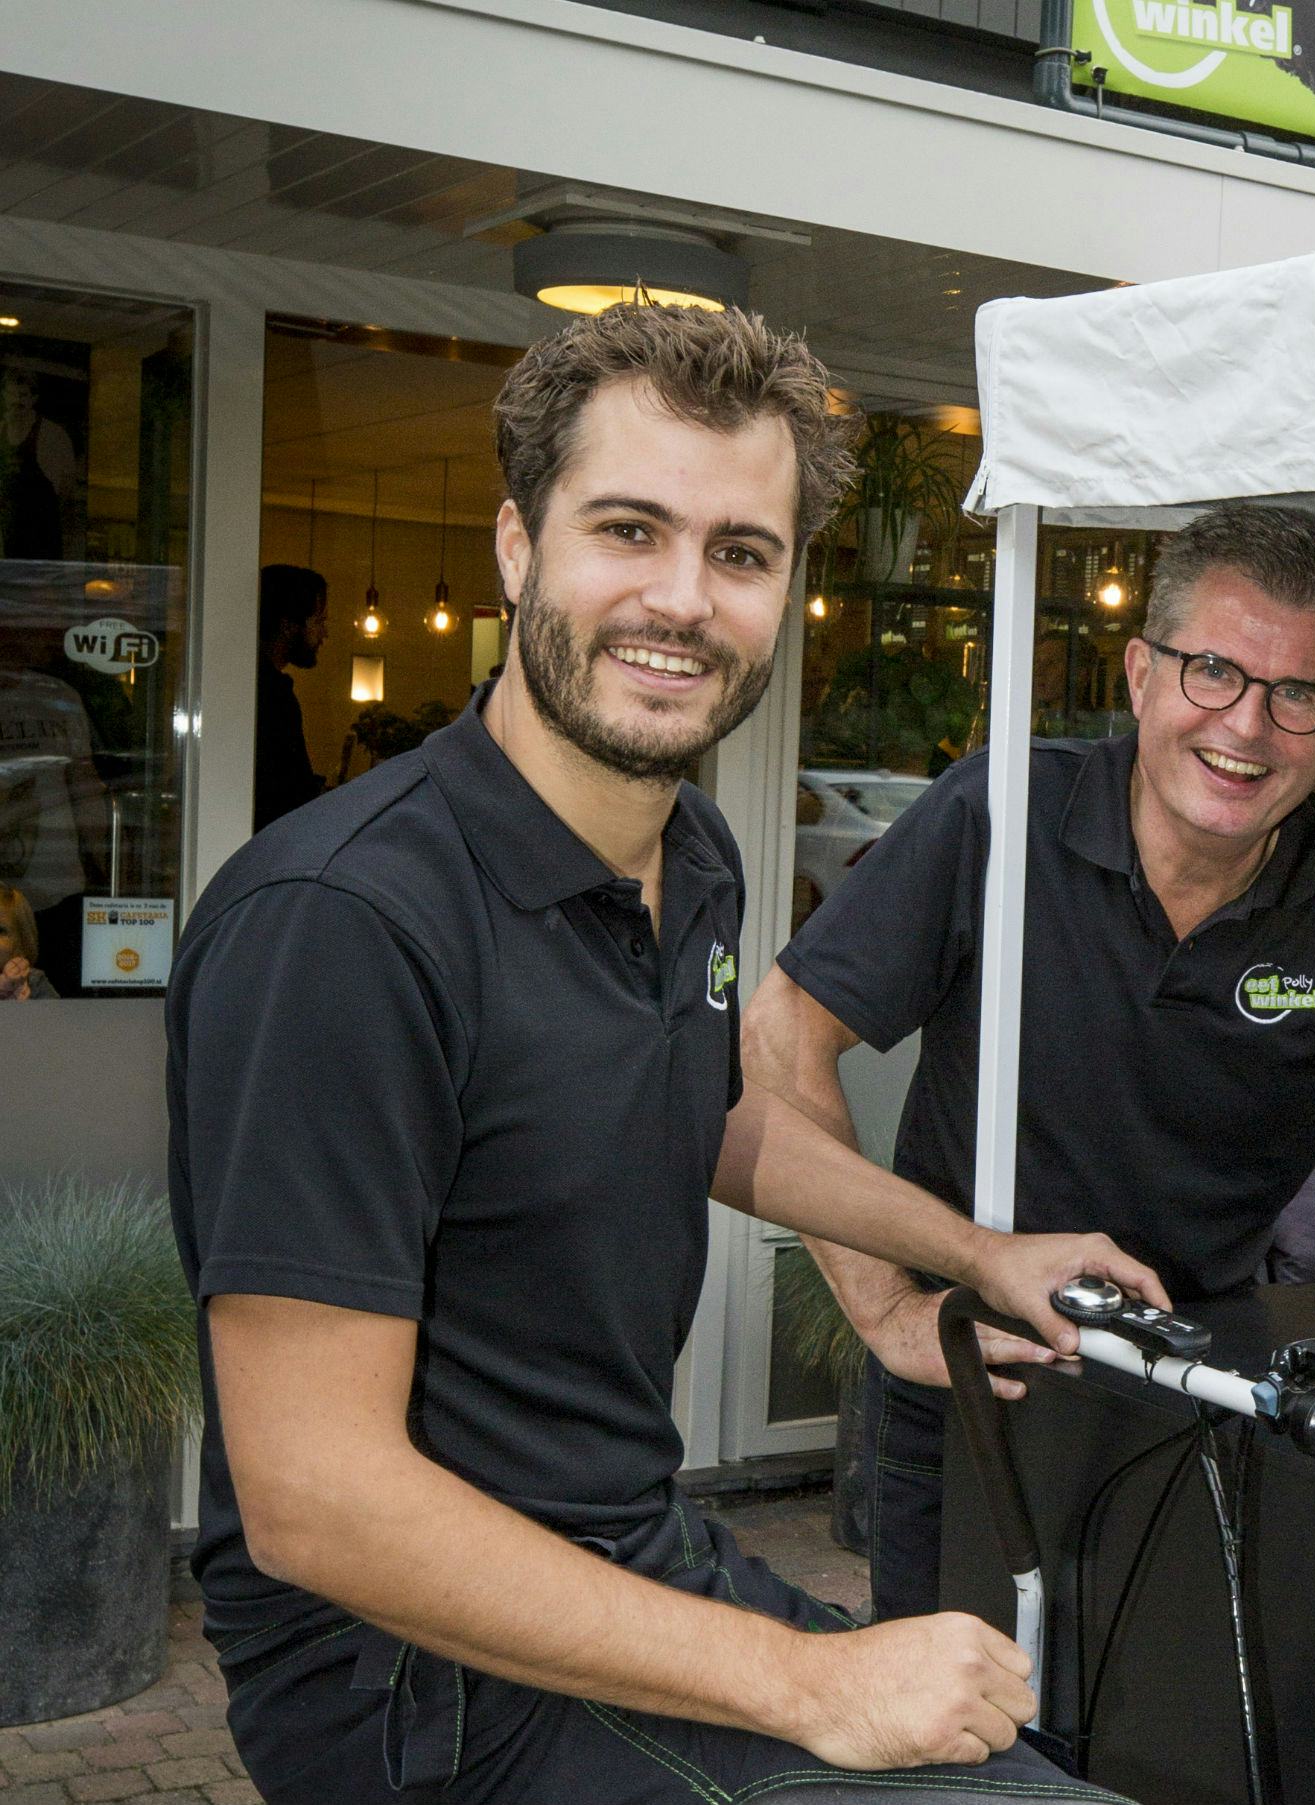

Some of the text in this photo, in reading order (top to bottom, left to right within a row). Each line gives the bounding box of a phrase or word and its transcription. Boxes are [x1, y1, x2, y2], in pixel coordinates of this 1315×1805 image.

[1132, 0, 1289, 53] winkel
[1246, 974, 1314, 994] eet Polly
